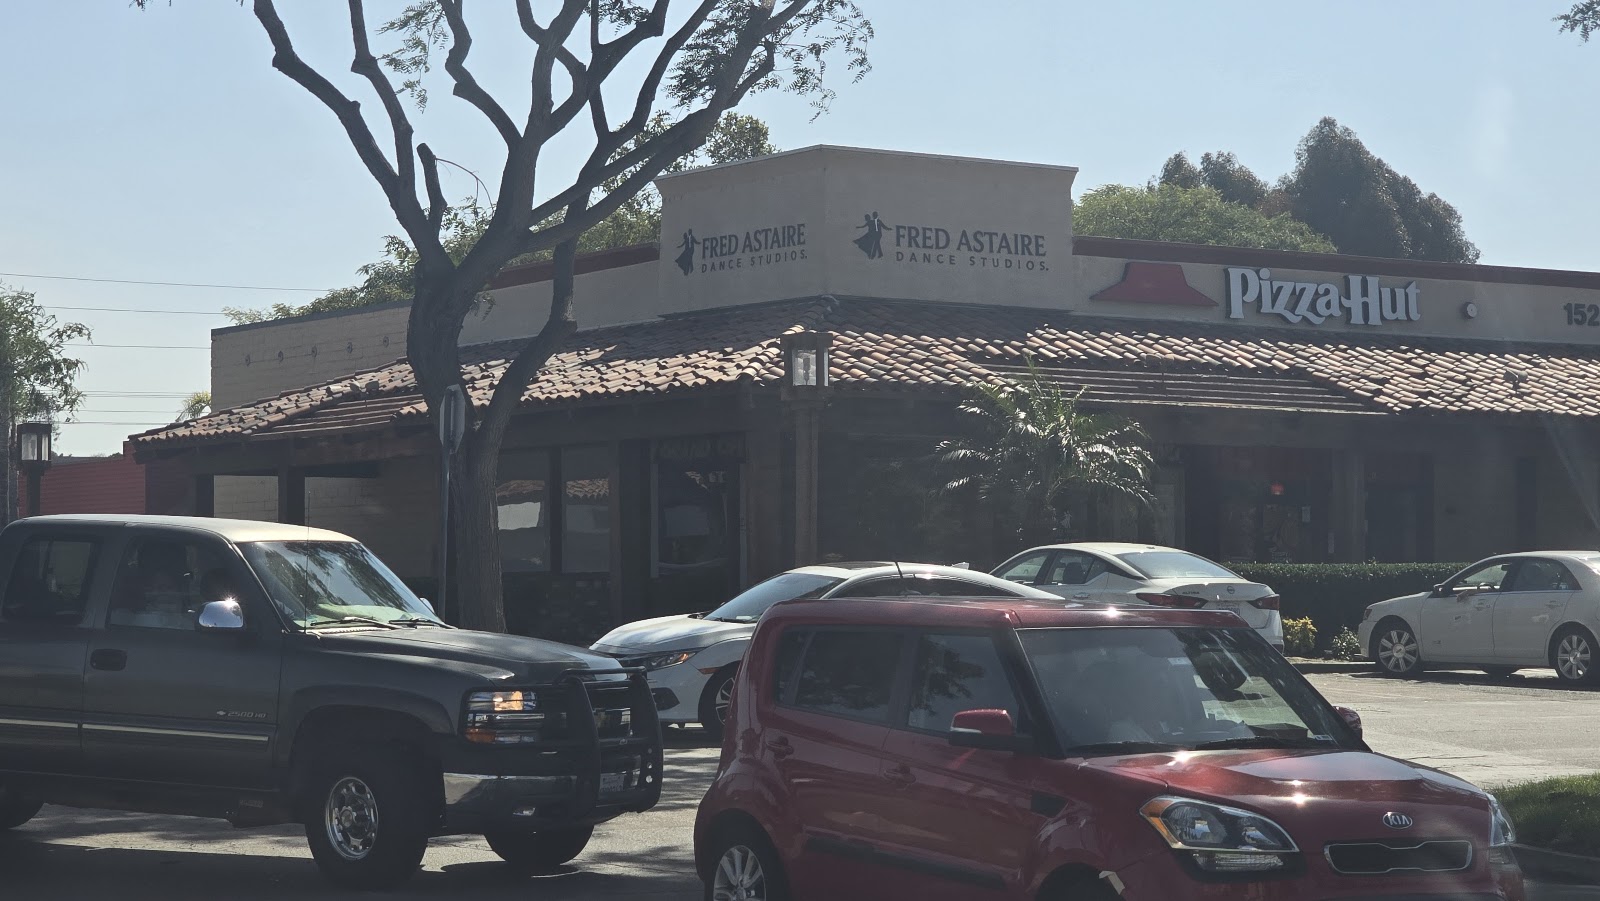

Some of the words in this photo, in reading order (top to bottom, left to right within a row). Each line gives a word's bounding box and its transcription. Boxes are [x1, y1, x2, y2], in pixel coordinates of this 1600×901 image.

[701, 233, 739, 260] FRED
[742, 223, 806, 254] ASTAIRE
[895, 224, 950, 250] FRED
[956, 229, 1047, 257] ASTAIRE
[701, 257, 742, 273] DANCE
[896, 251, 956, 265] DANCE
[1227, 267, 1342, 325] Pizza
[1341, 274, 1421, 326] Hut
[1563, 302, 1600, 327] 152
[1388, 814, 1410, 825] KIA
